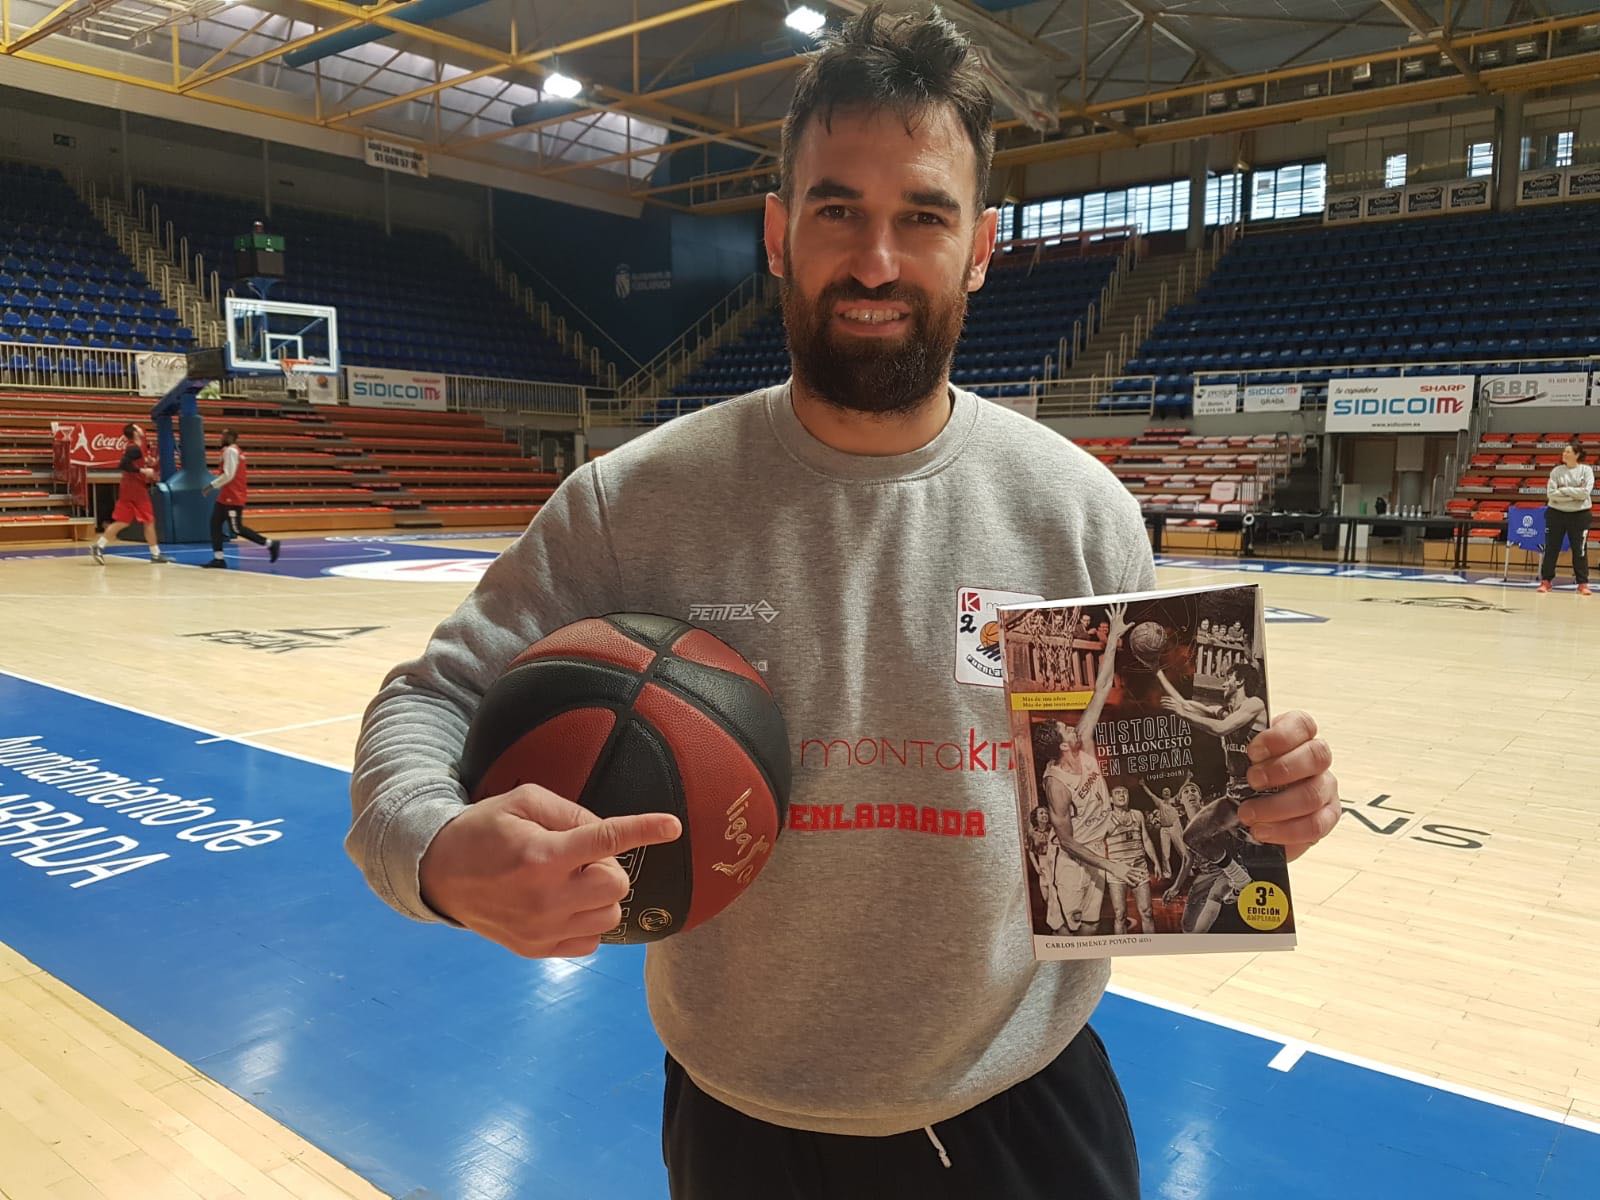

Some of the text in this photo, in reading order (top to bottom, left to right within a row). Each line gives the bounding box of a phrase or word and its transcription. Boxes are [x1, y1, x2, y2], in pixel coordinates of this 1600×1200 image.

[1420, 384, 1466, 393] SHARP
[688, 603, 756, 621] PENTEX
[1096, 714, 1192, 745] HISTORIA
[1097, 735, 1193, 757] DEL BALONCESTO
[1099, 747, 1194, 777] EN ESPAÑA
[176, 818, 285, 852] de
[1109, 937, 1137, 945] POYATO
